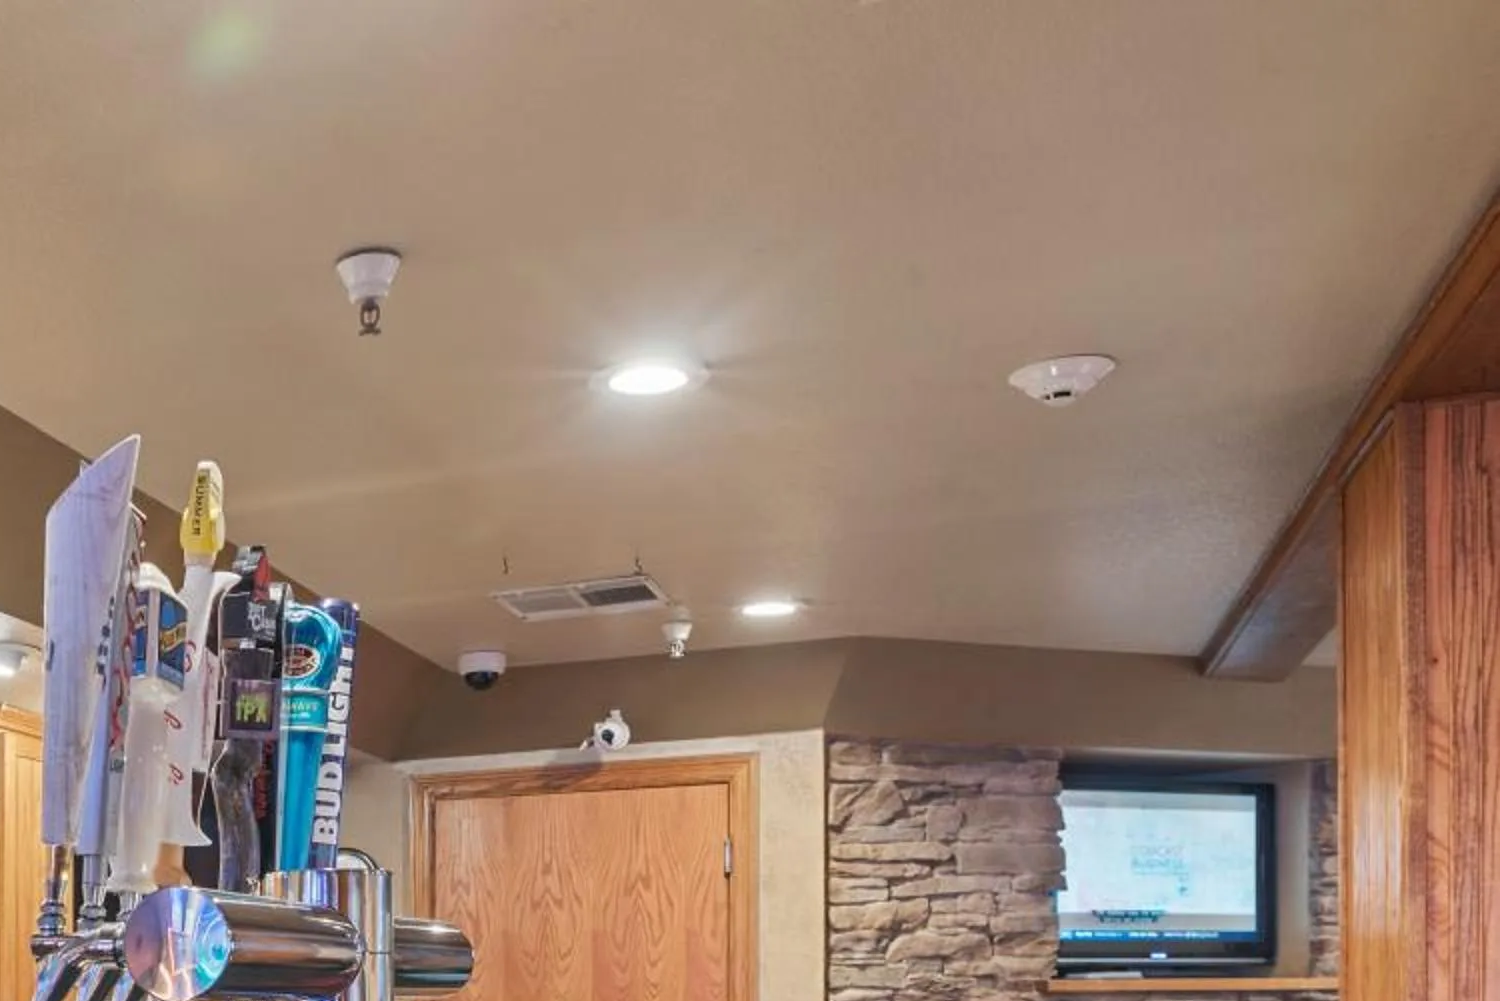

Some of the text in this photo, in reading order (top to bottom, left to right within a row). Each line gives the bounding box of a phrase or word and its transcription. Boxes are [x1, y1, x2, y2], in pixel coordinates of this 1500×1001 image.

[192, 475, 209, 537] SUMMER
[236, 693, 268, 722] IPA
[312, 760, 343, 843] BUD
